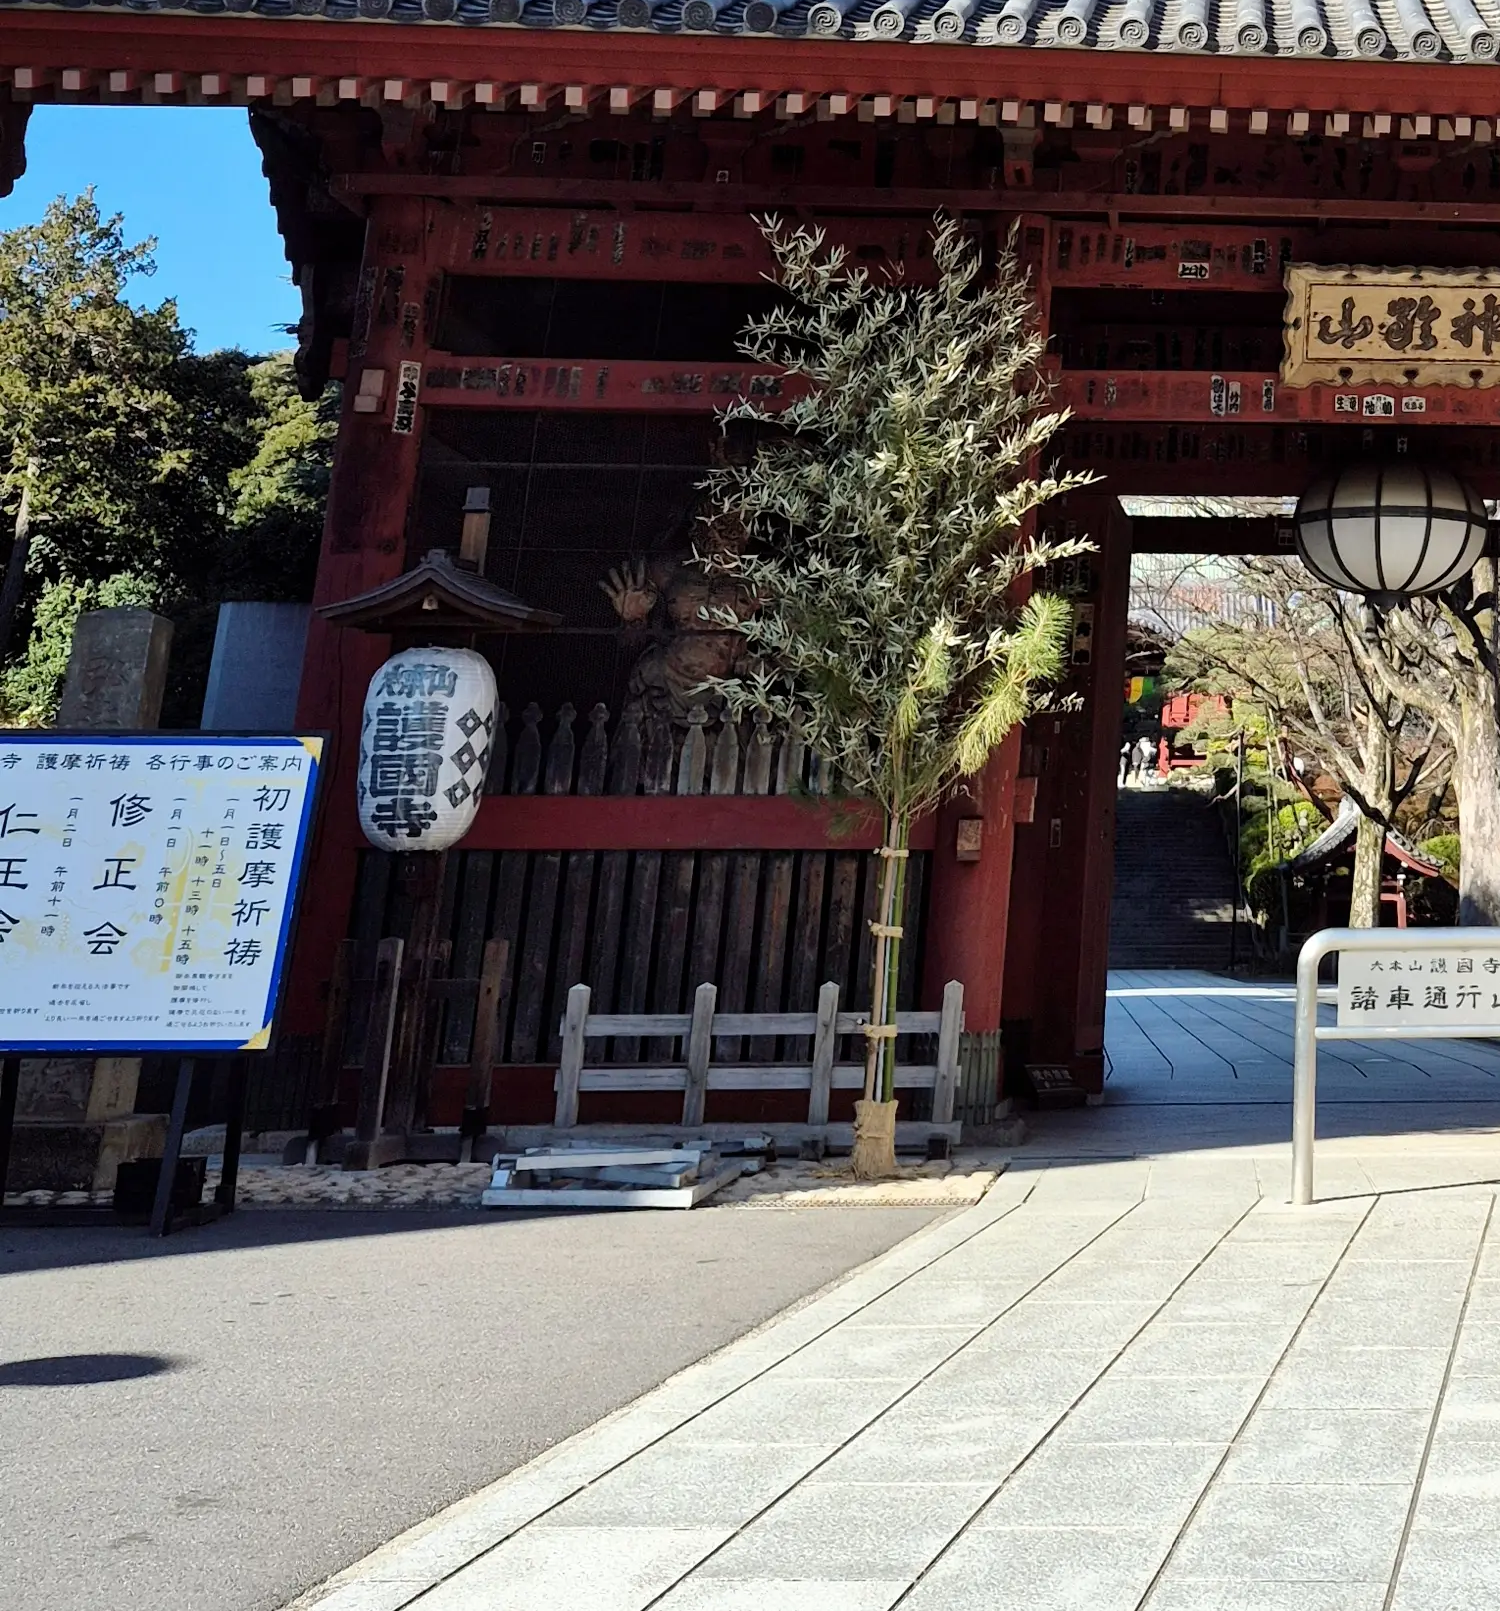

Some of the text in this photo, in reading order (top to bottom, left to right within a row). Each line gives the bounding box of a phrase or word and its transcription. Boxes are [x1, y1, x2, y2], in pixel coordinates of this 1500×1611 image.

[145, 753, 303, 772] 各行事のご案内
[83, 793, 153, 956] 修正会
[223, 784, 291, 966] 初護摩祈祷
